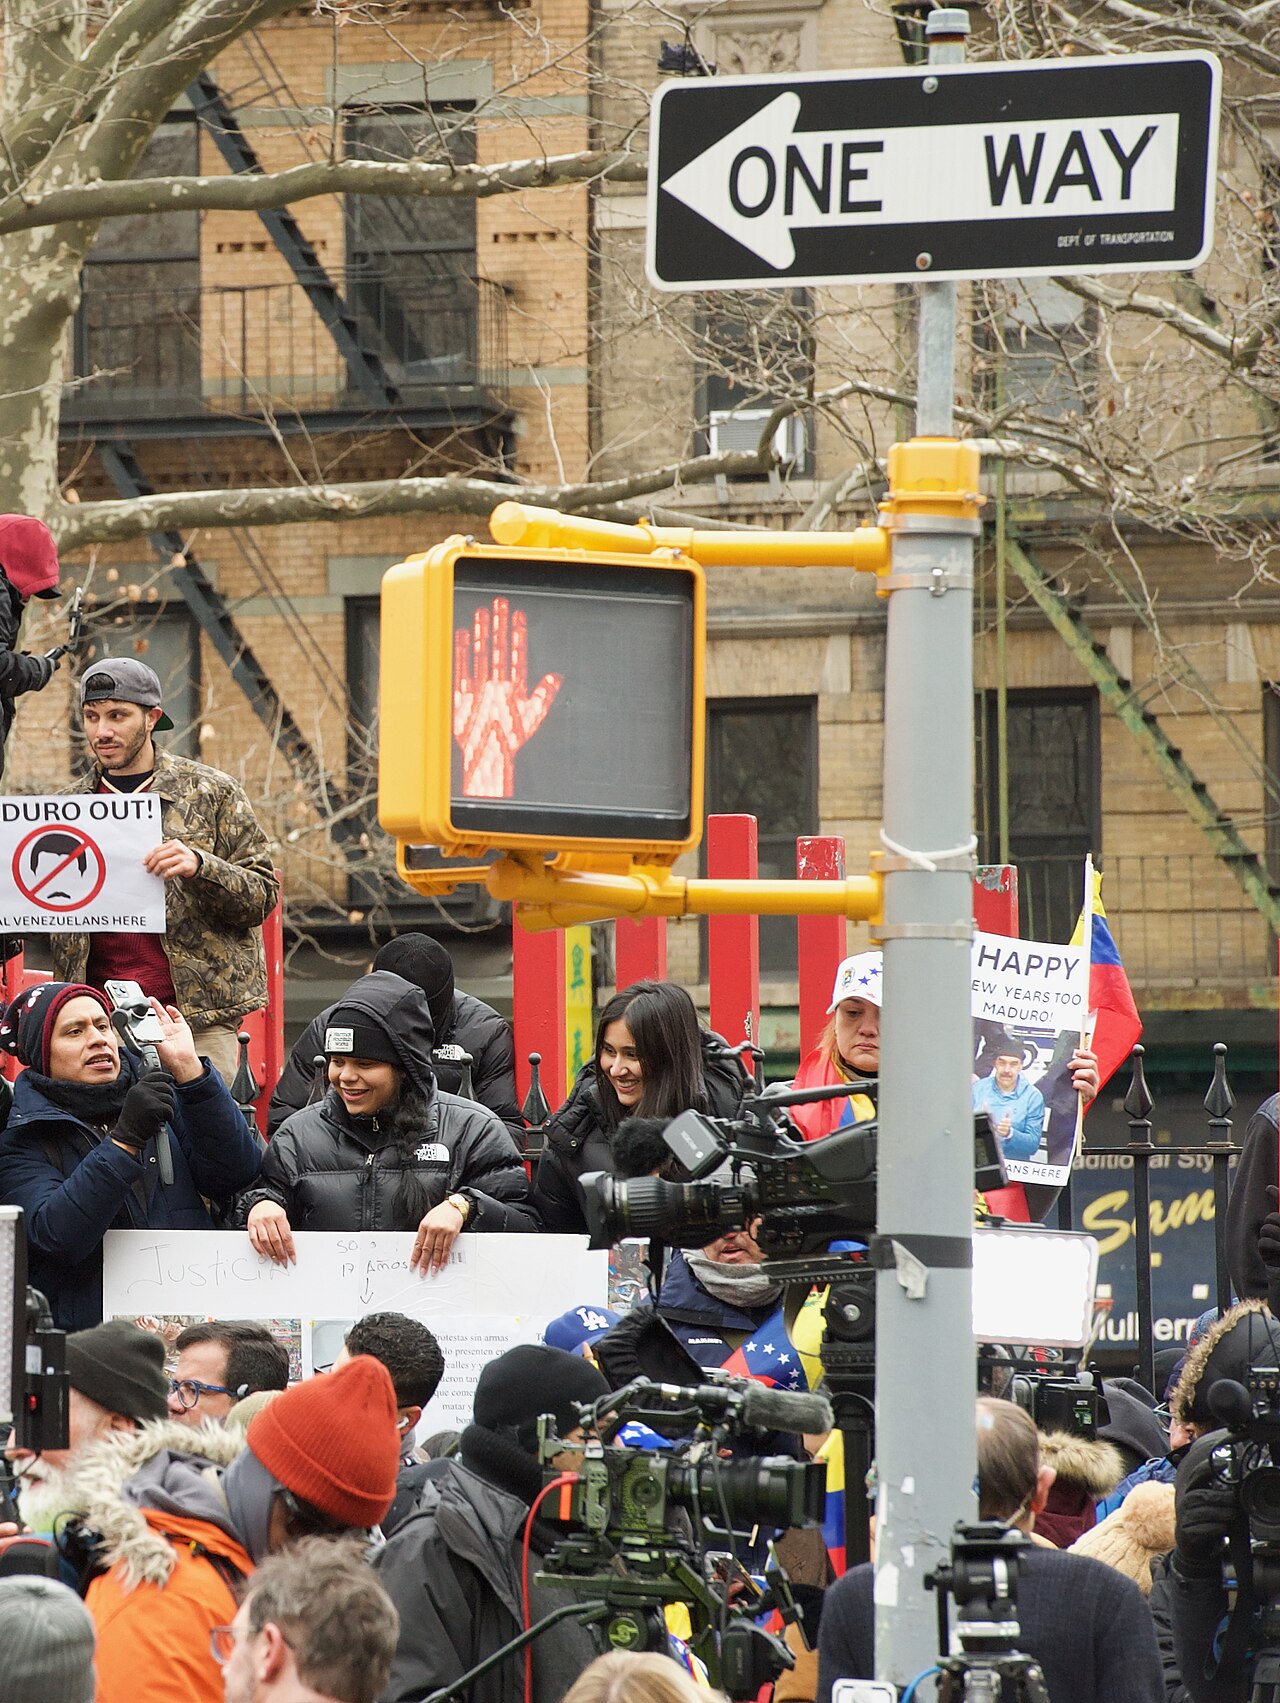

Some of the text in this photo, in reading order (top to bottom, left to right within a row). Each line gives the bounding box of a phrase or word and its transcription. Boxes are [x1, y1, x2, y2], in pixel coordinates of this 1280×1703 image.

[729, 125, 1158, 218] ONE WAY
[1084, 234, 1096, 246] OF
[1100, 231, 1174, 245] TRANSPORTATION
[89, 799, 154, 820] OUT!
[13, 915, 110, 926] VENEZUELANS
[112, 915, 147, 926] HERE
[977, 944, 1080, 981] HAPPY
[972, 979, 1082, 1006] EW YEARS TOO
[983, 1002, 1053, 1023] MADURO!
[1032, 1165, 1062, 1180] HERE
[576, 1307, 610, 1331] LA
[470, 1333, 482, 1342] sin
[440, 1347, 453, 1356] olo
[455, 1347, 493, 1358] presenten
[446, 1361, 469, 1370] calles
[440, 1375, 464, 1384] ueron
[434, 1389, 449, 1398] que
[442, 1403, 465, 1411] matar
